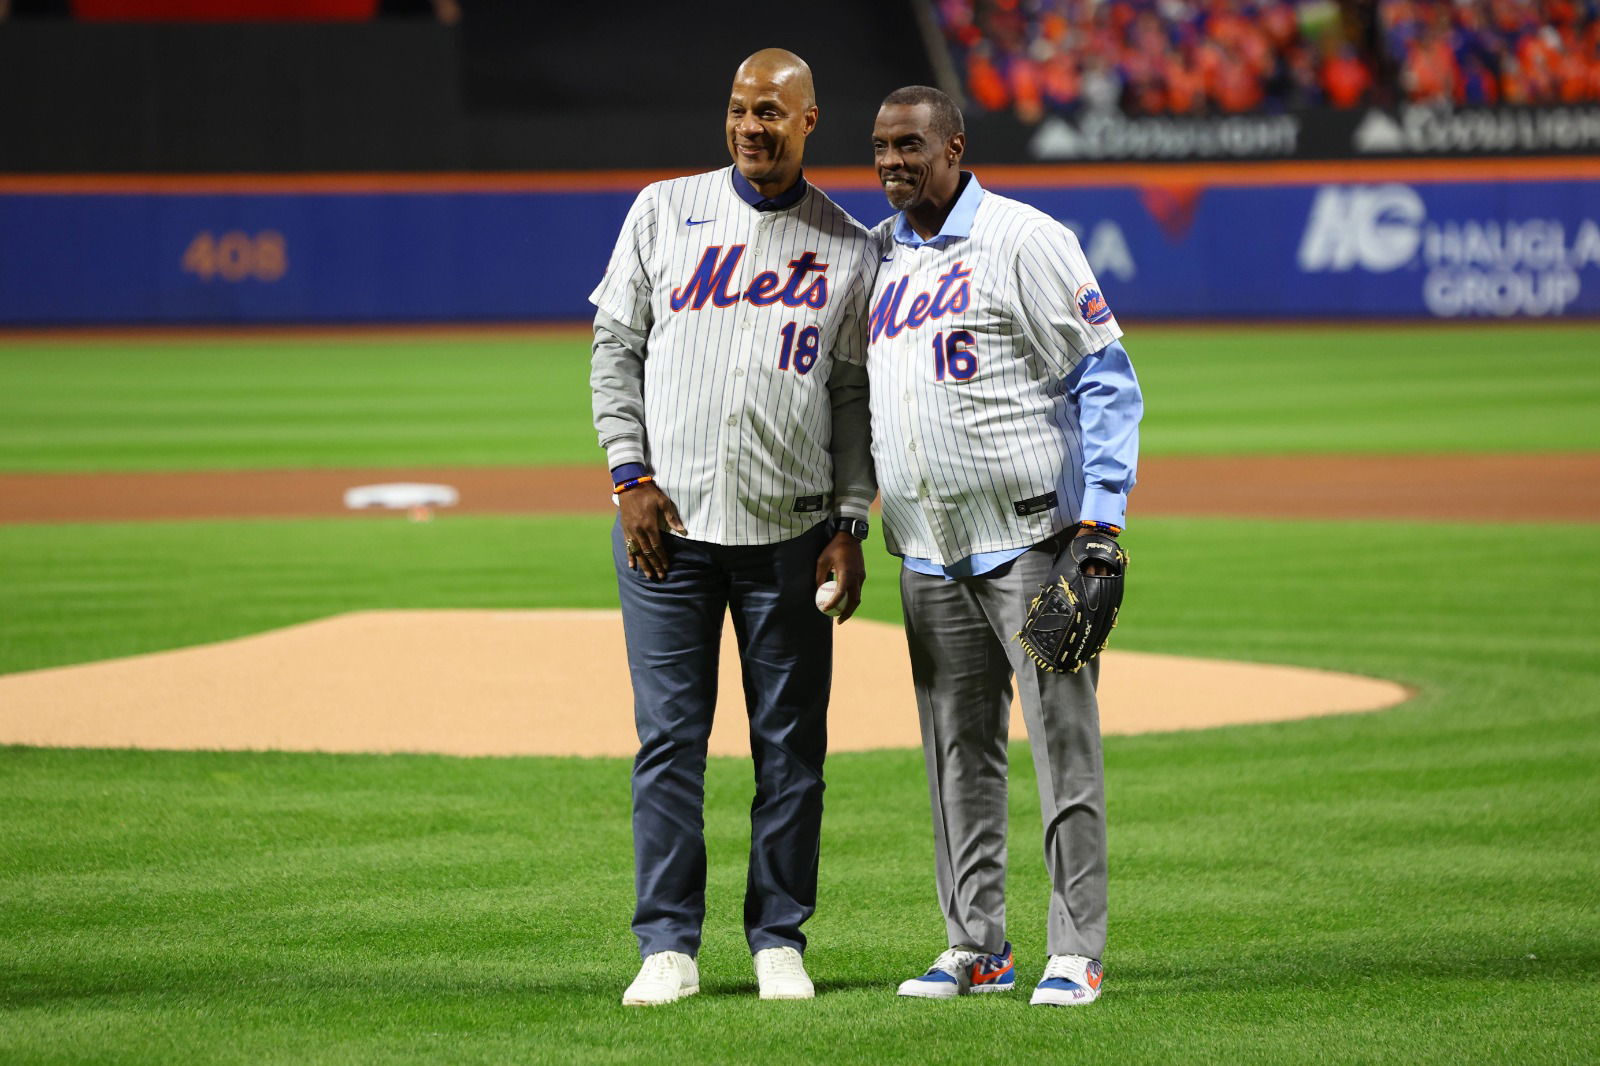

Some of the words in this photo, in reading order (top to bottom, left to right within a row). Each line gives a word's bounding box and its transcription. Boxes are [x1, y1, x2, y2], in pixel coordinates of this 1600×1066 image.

[182, 229, 287, 283] 408
[670, 244, 830, 313] Mets
[868, 261, 973, 344] Mets
[1424, 265, 1581, 317] GROUP
[778, 321, 820, 375] 18
[932, 330, 978, 382] 16
